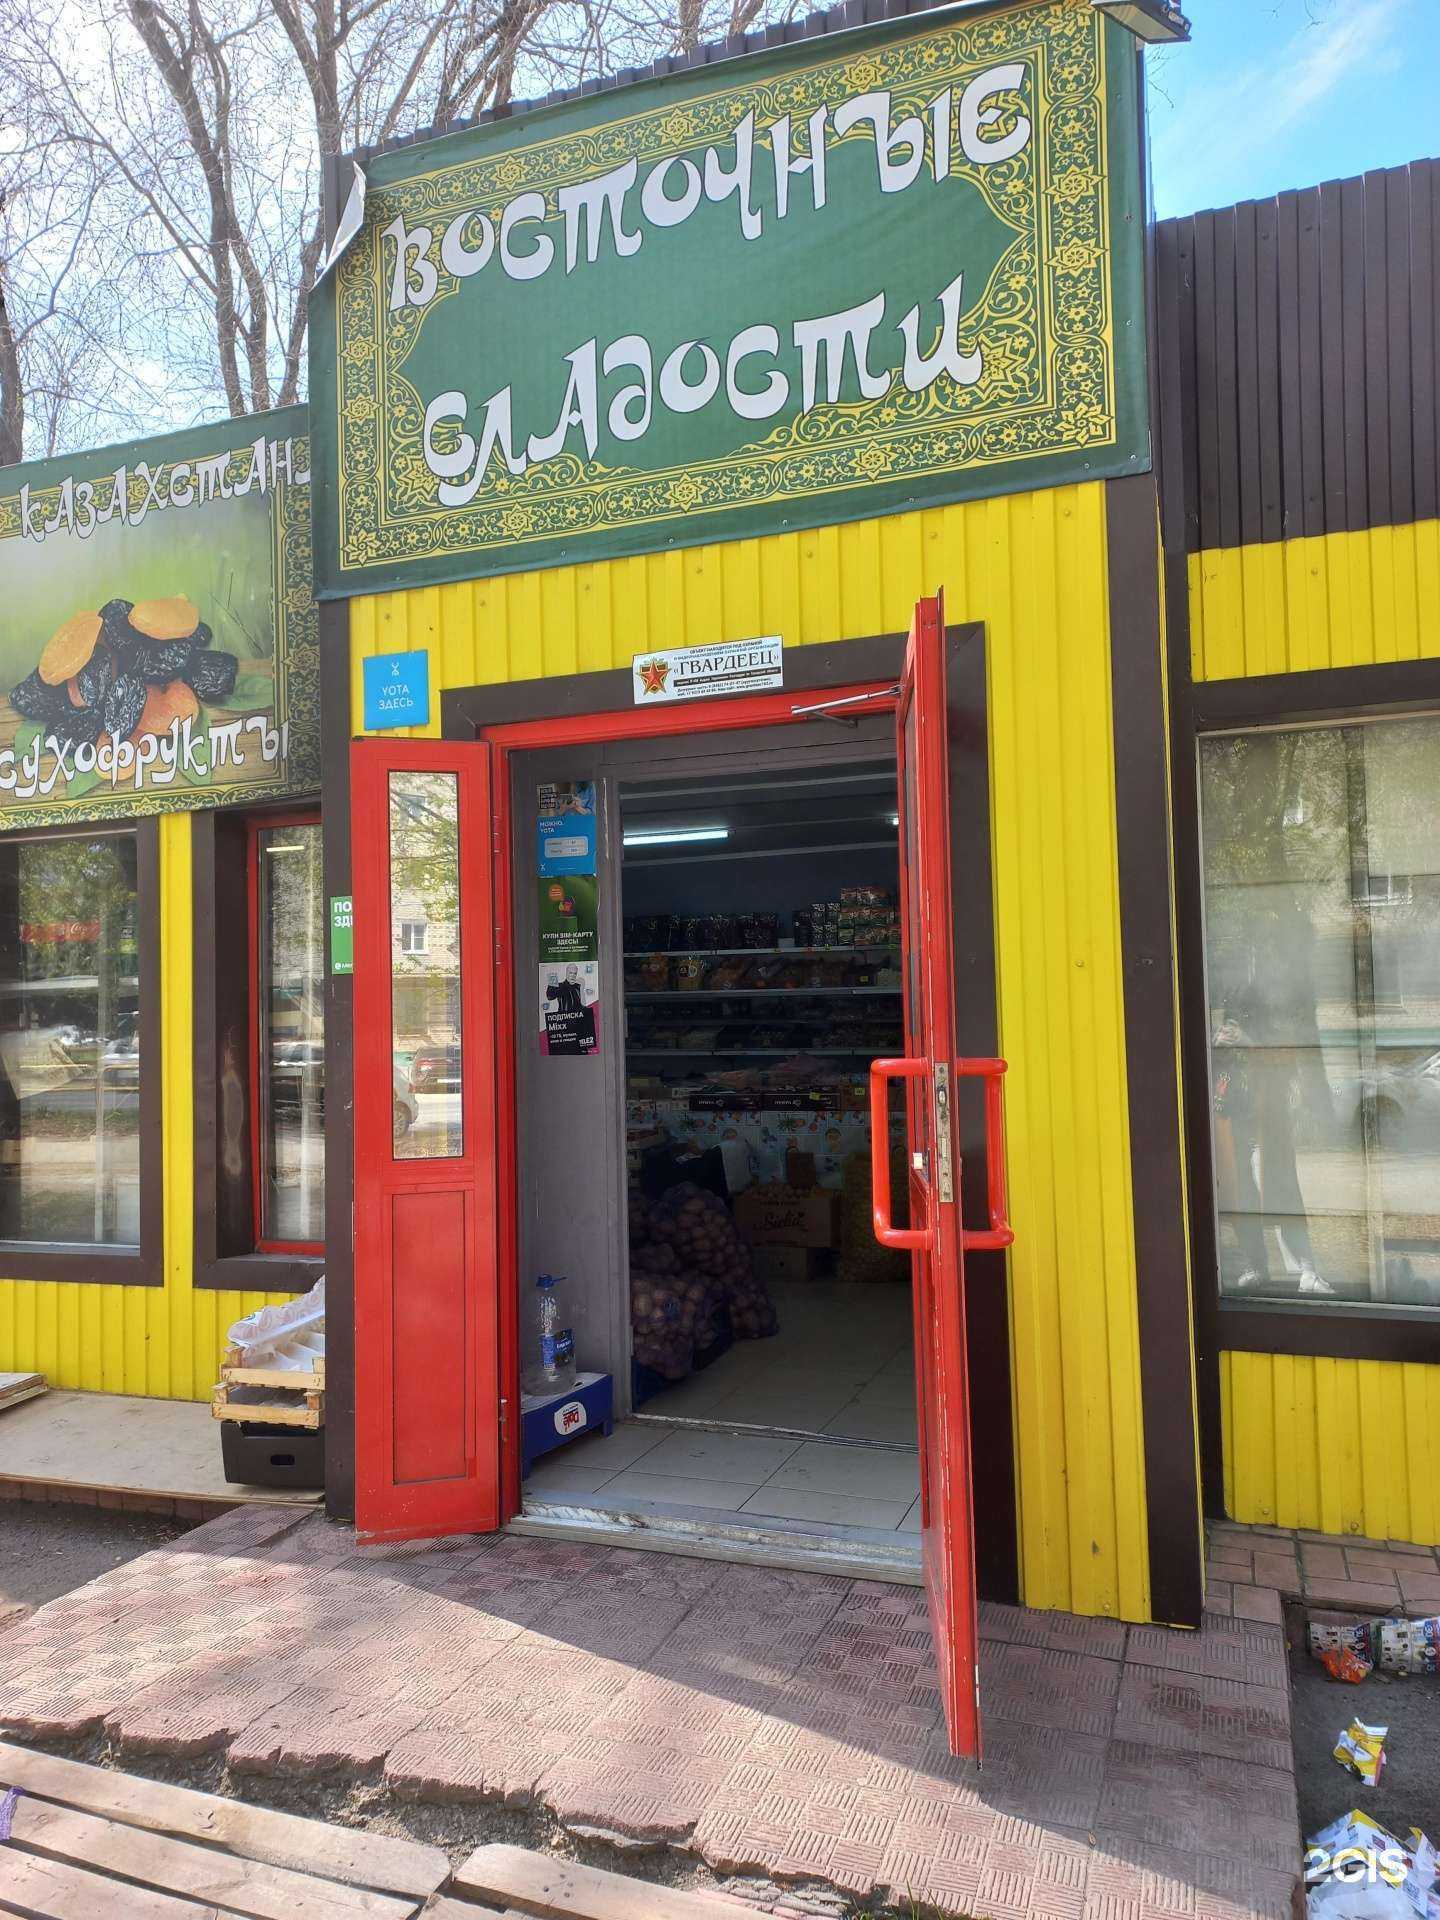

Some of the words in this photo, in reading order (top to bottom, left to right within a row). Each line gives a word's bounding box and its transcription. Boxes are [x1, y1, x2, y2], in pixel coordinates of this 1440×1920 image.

[380, 63, 1032, 312] ВОСТОЧНЫЕ
[423, 271, 984, 508] СЛАДОСТИ
[382, 684, 410, 696] YOTA
[378, 697, 414, 710] ЗДЕСЬ
[547, 1011, 584, 1022] ПОДПИСКА
